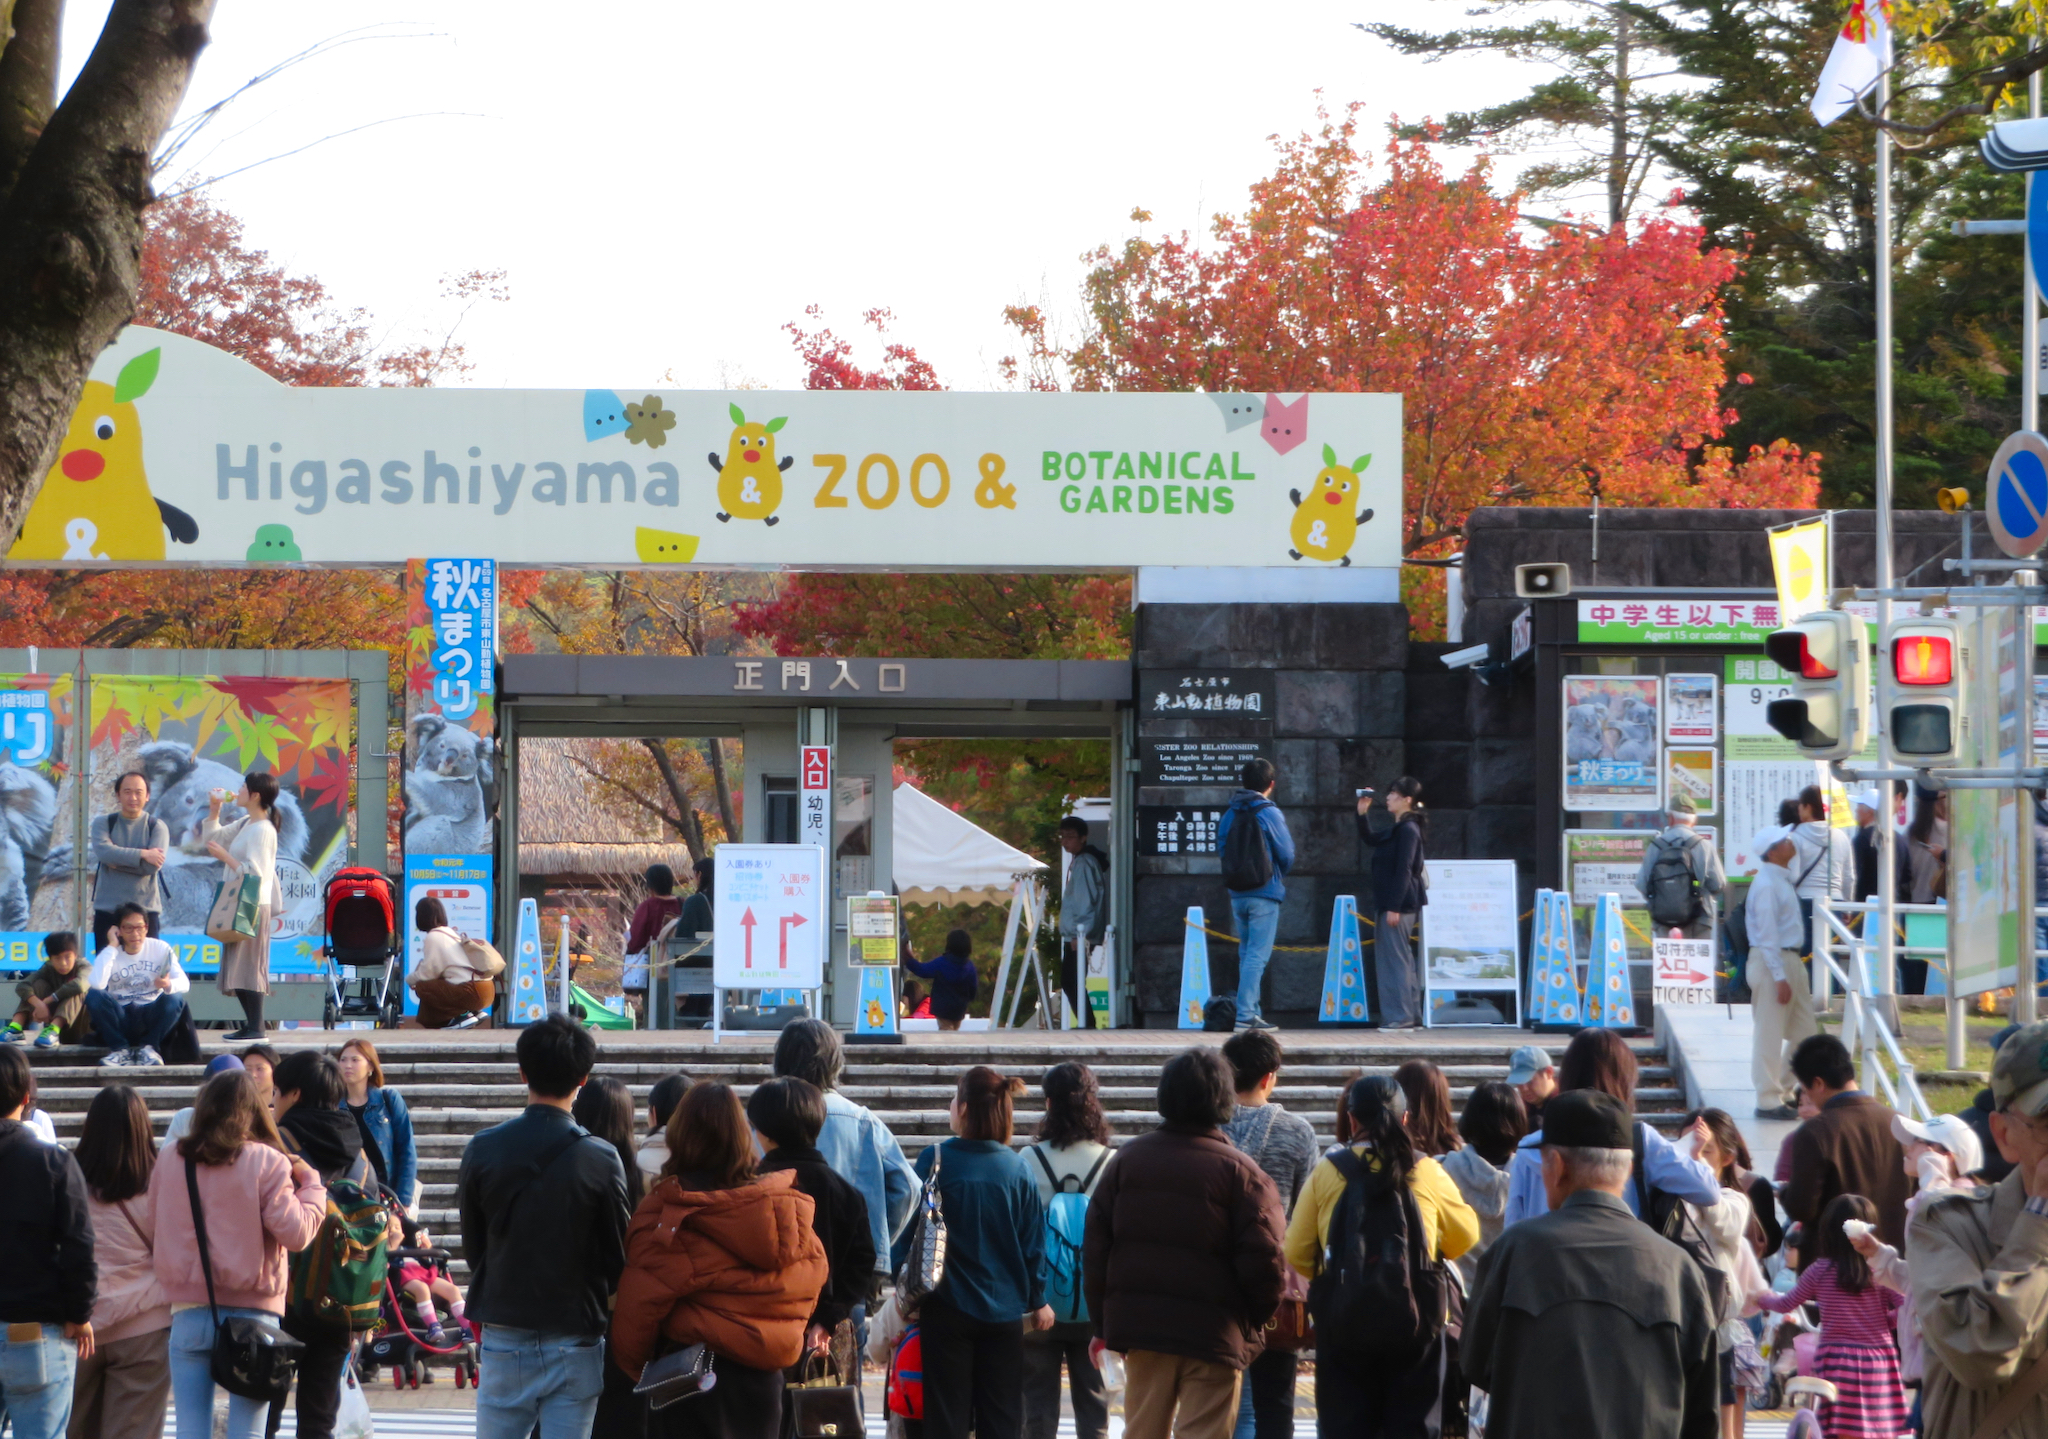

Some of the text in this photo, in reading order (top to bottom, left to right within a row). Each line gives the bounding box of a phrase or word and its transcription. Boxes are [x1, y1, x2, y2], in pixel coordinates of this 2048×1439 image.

[1042, 450, 1256, 481] BOTANICAL
[216, 442, 680, 515] Higashiyama
[812, 452, 1018, 510] ZOO &
[1060, 484, 1235, 515] GARDENS
[1590, 604, 1778, 626] 中学生以下無
[431, 560, 482, 713] 秋まつり
[481, 588, 492, 690] 名古屋市東山動植物園
[1644, 630, 1671, 642] Aged
[1674, 631, 1686, 640] 15
[1702, 630, 1731, 640] under
[1740, 630, 1760, 640] free
[733, 660, 906, 692] 正門入口
[0, 692, 46, 708] 植物園
[1153, 691, 1261, 712] 東山動植物園
[1174, 754, 1200, 762] Angeles
[807, 751, 824, 787] 入口
[1164, 764, 1192, 772] Taronga
[1580, 760, 1643, 781] 秋まつり
[1159, 774, 1199, 782] Chapultepec
[1157, 821, 1178, 832] 午前
[1157, 831, 1178, 841] 午後
[726, 860, 772, 869] 入園券あり
[779, 873, 811, 884] 入園券
[1655, 943, 1710, 957] 切符売場
[1656, 957, 1688, 972] 入口
[1654, 986, 1713, 1005] TICKETS
